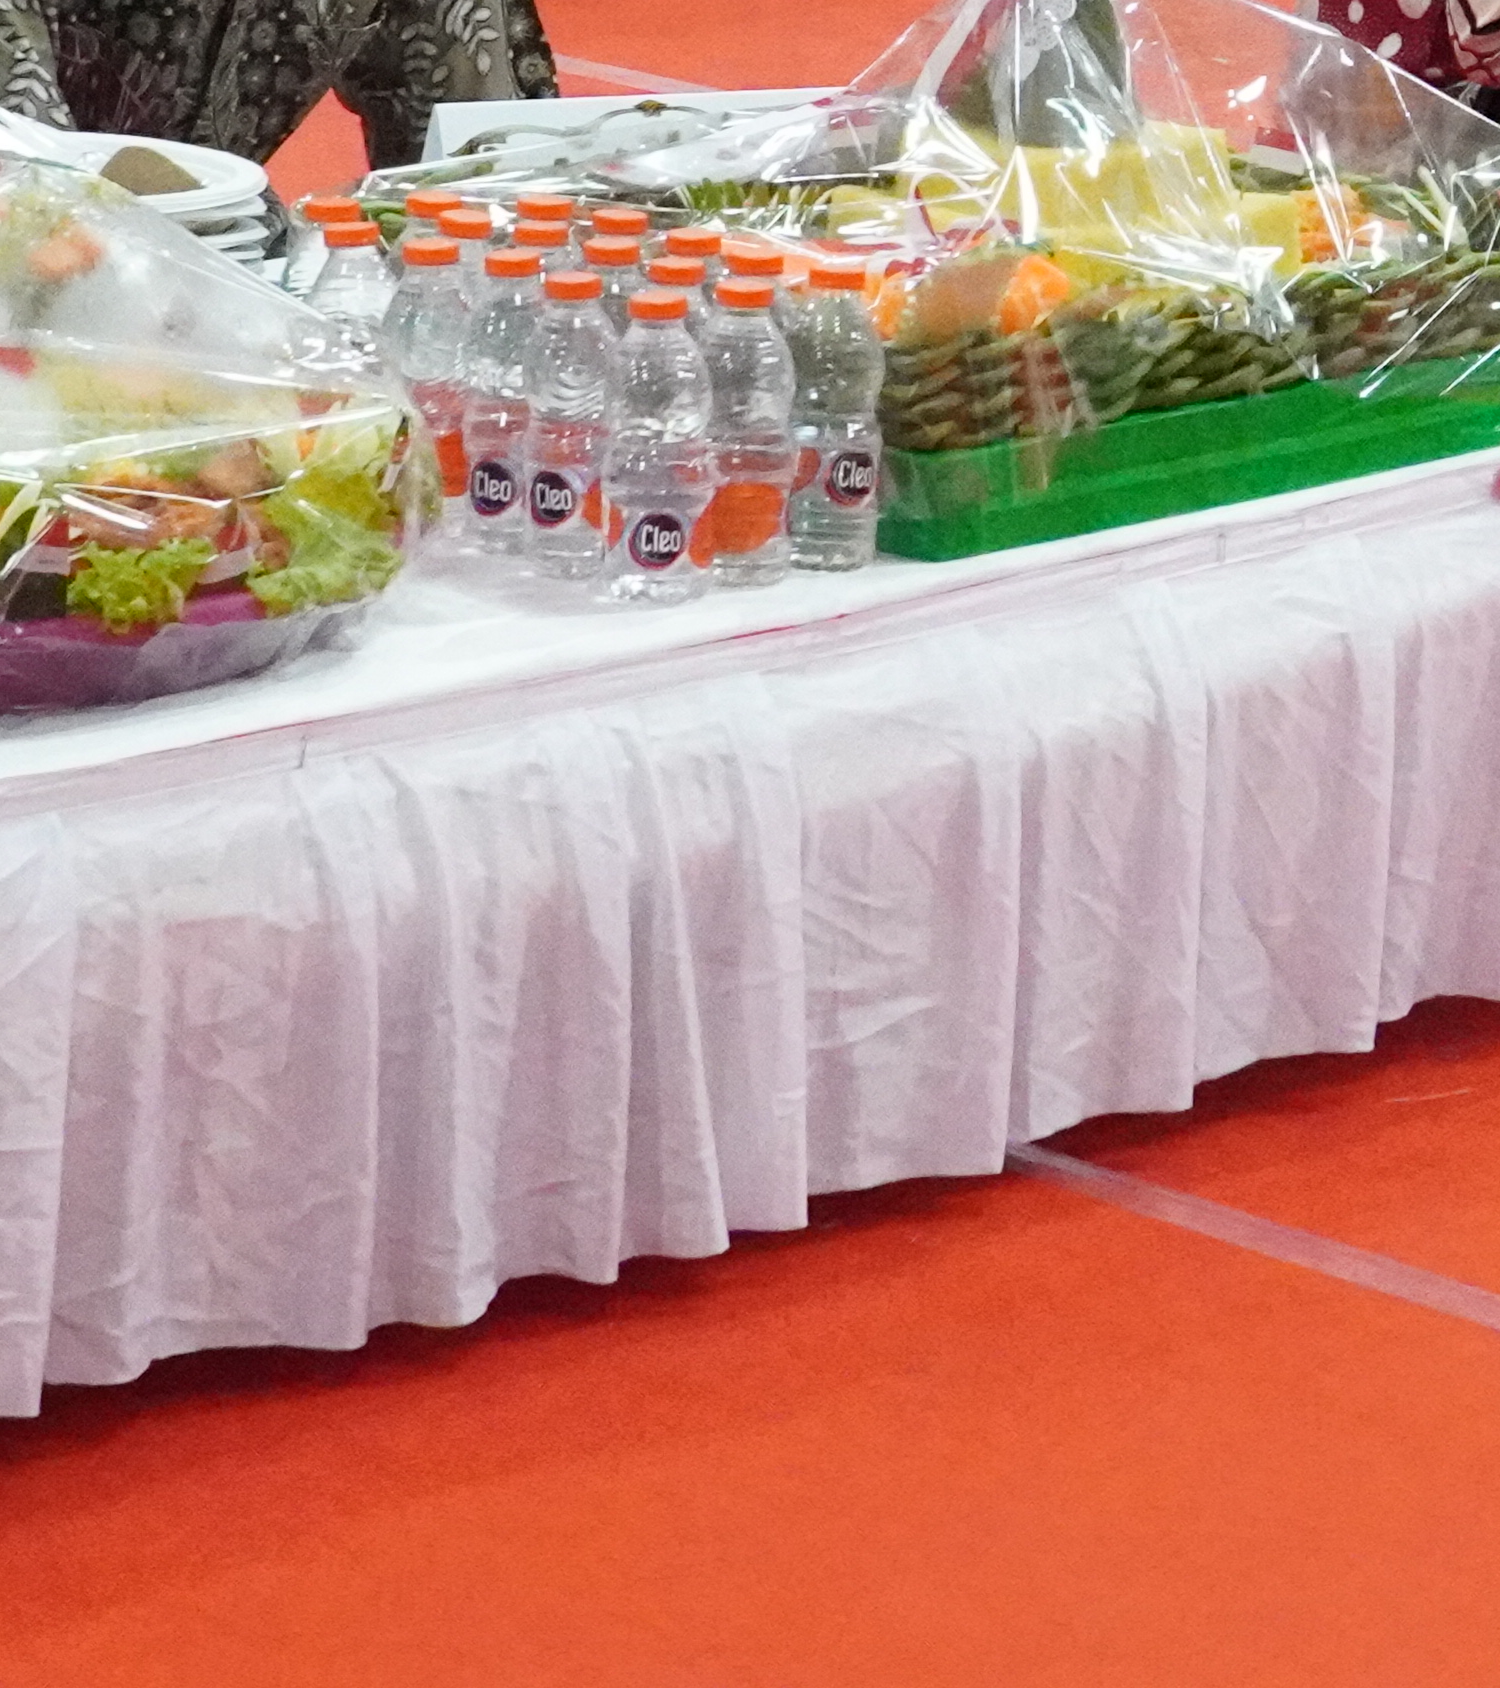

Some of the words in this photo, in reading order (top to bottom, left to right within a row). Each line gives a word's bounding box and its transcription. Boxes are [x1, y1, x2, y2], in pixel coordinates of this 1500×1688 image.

[475, 470, 512, 502] Cleo
[838, 460, 872, 488] Cleo
[536, 482, 572, 510] Cleo
[641, 524, 682, 553] Cleo
